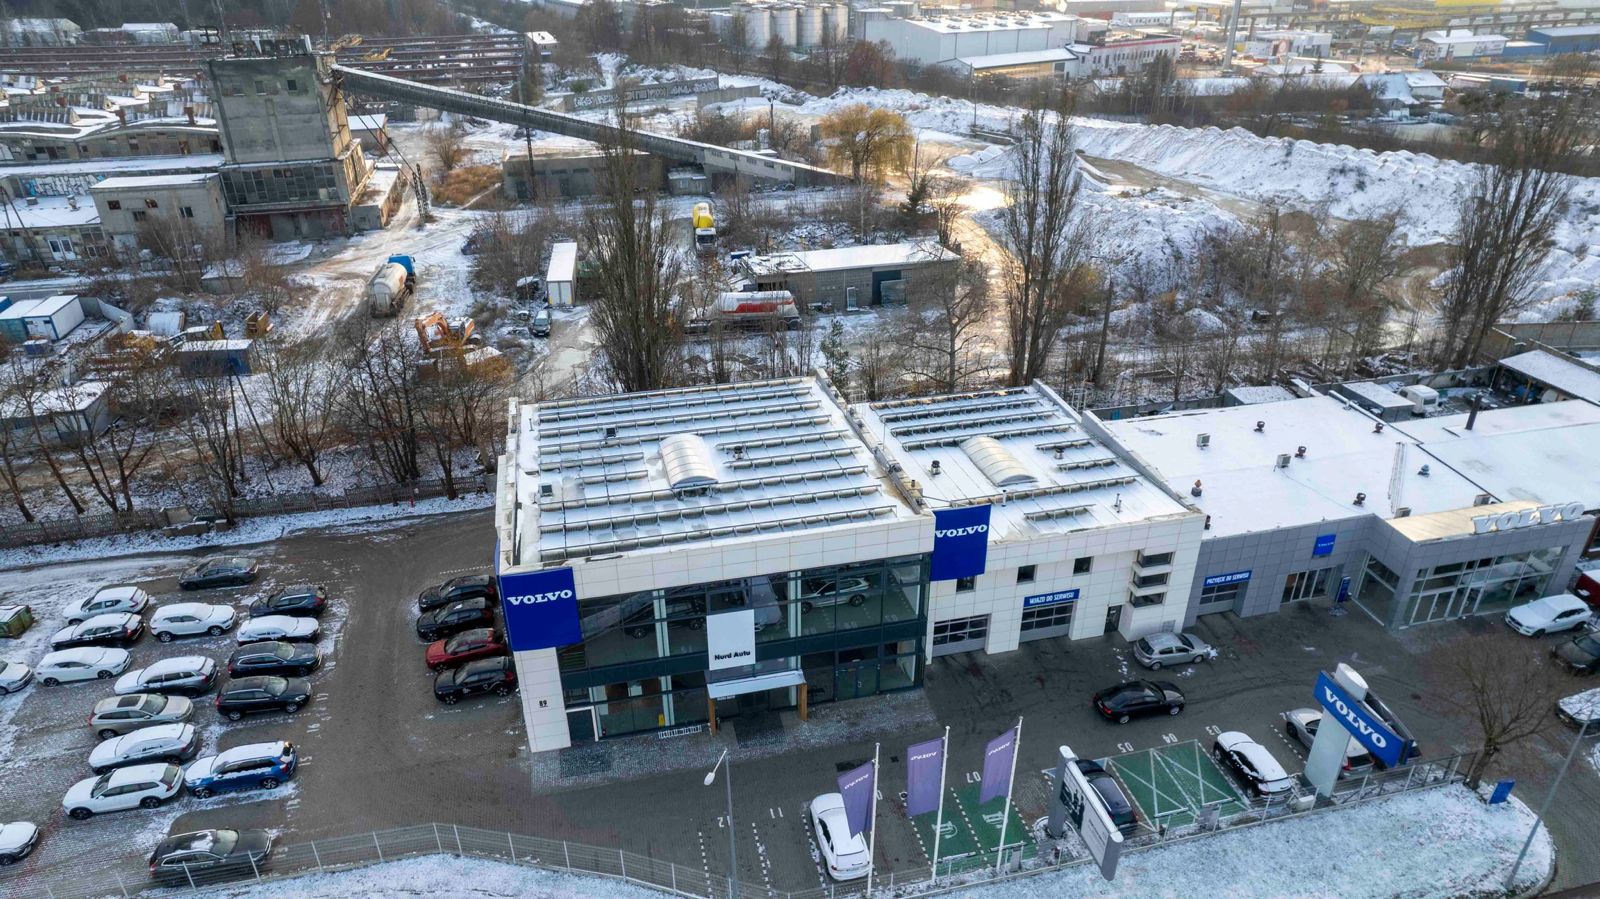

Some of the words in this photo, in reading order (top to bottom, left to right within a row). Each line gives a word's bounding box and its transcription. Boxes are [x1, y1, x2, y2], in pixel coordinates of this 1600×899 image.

[1472, 502, 1585, 535] VOLVO
[935, 524, 988, 538] VOLVO
[507, 589, 573, 606] VOLVO
[1053, 591, 1075, 601] SERWISU
[714, 652, 732, 661] Nord
[733, 650, 751, 658] Auto
[1324, 686, 1386, 748] VOLVO
[1205, 725, 1222, 736] 03
[1161, 733, 1178, 744] 04
[1117, 742, 1134, 753] 05
